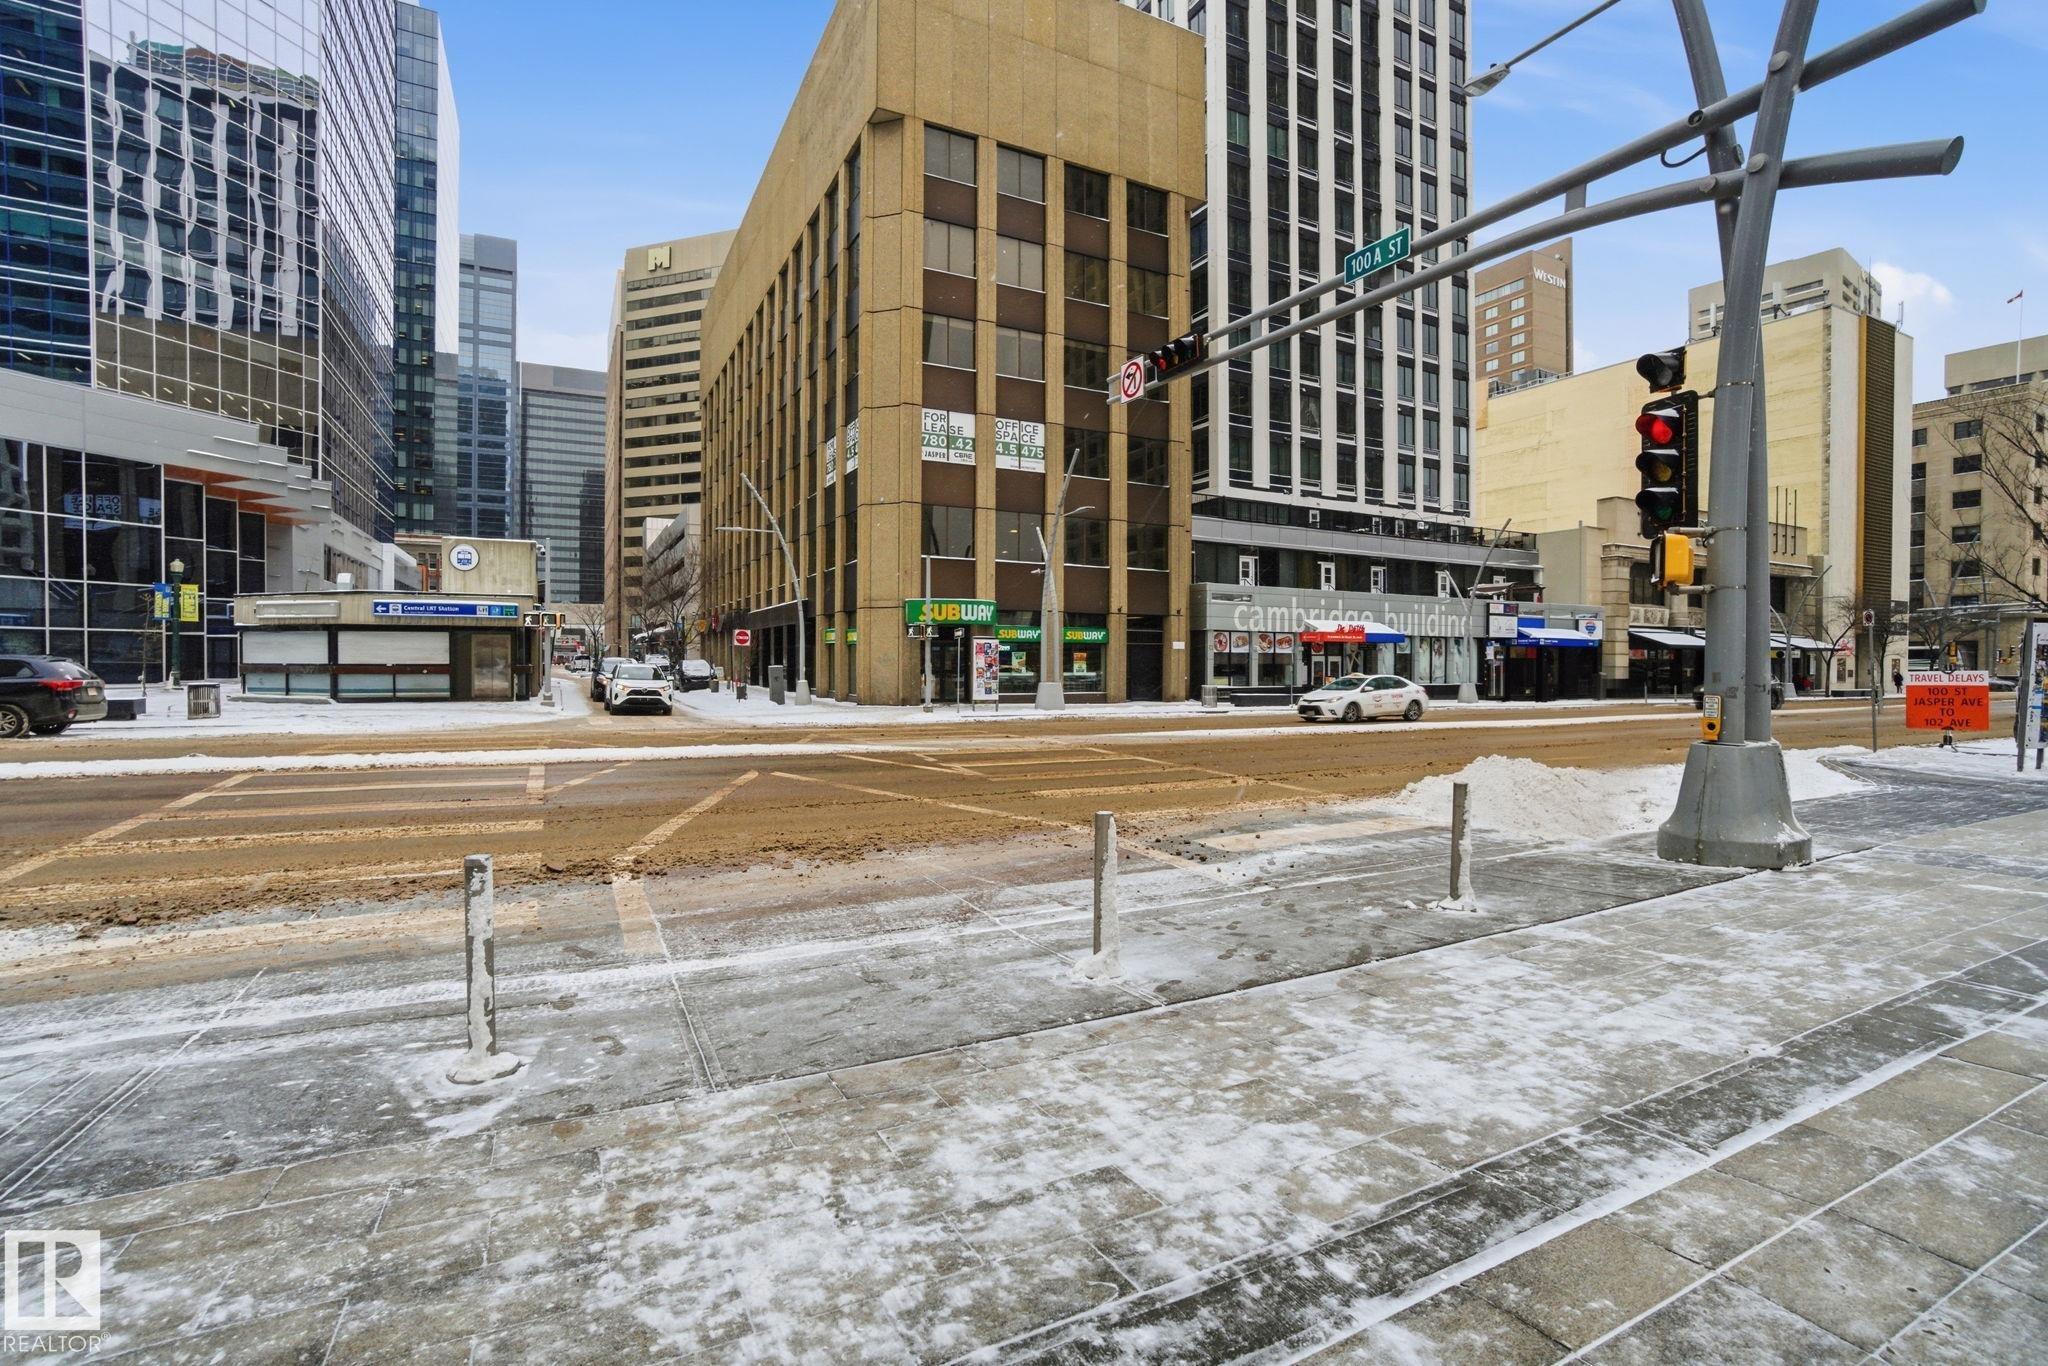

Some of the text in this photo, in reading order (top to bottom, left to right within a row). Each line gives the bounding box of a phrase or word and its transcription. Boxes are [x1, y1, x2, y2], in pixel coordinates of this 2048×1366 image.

[1388, 236, 1403, 258] ST
[1533, 266, 1566, 289] WESTIN
[924, 412, 946, 423] FOR
[924, 423, 964, 436] LEASE
[996, 420, 1039, 435] OFFICE
[996, 431, 1036, 444] SPACE
[924, 451, 946, 459] JASPER
[919, 603, 994, 622] SUBWAY
[998, 629, 1039, 639] SUBWAY
[1065, 631, 1104, 640] SUBWAY
[1909, 673, 1985, 682] TRAVEL DELAYS
[1928, 687, 1967, 696] 100 ST
[1913, 698, 1983, 706] JASPER AVE
[1940, 708, 1955, 716] TO
[1924, 718, 1972, 727] 102 AVE
